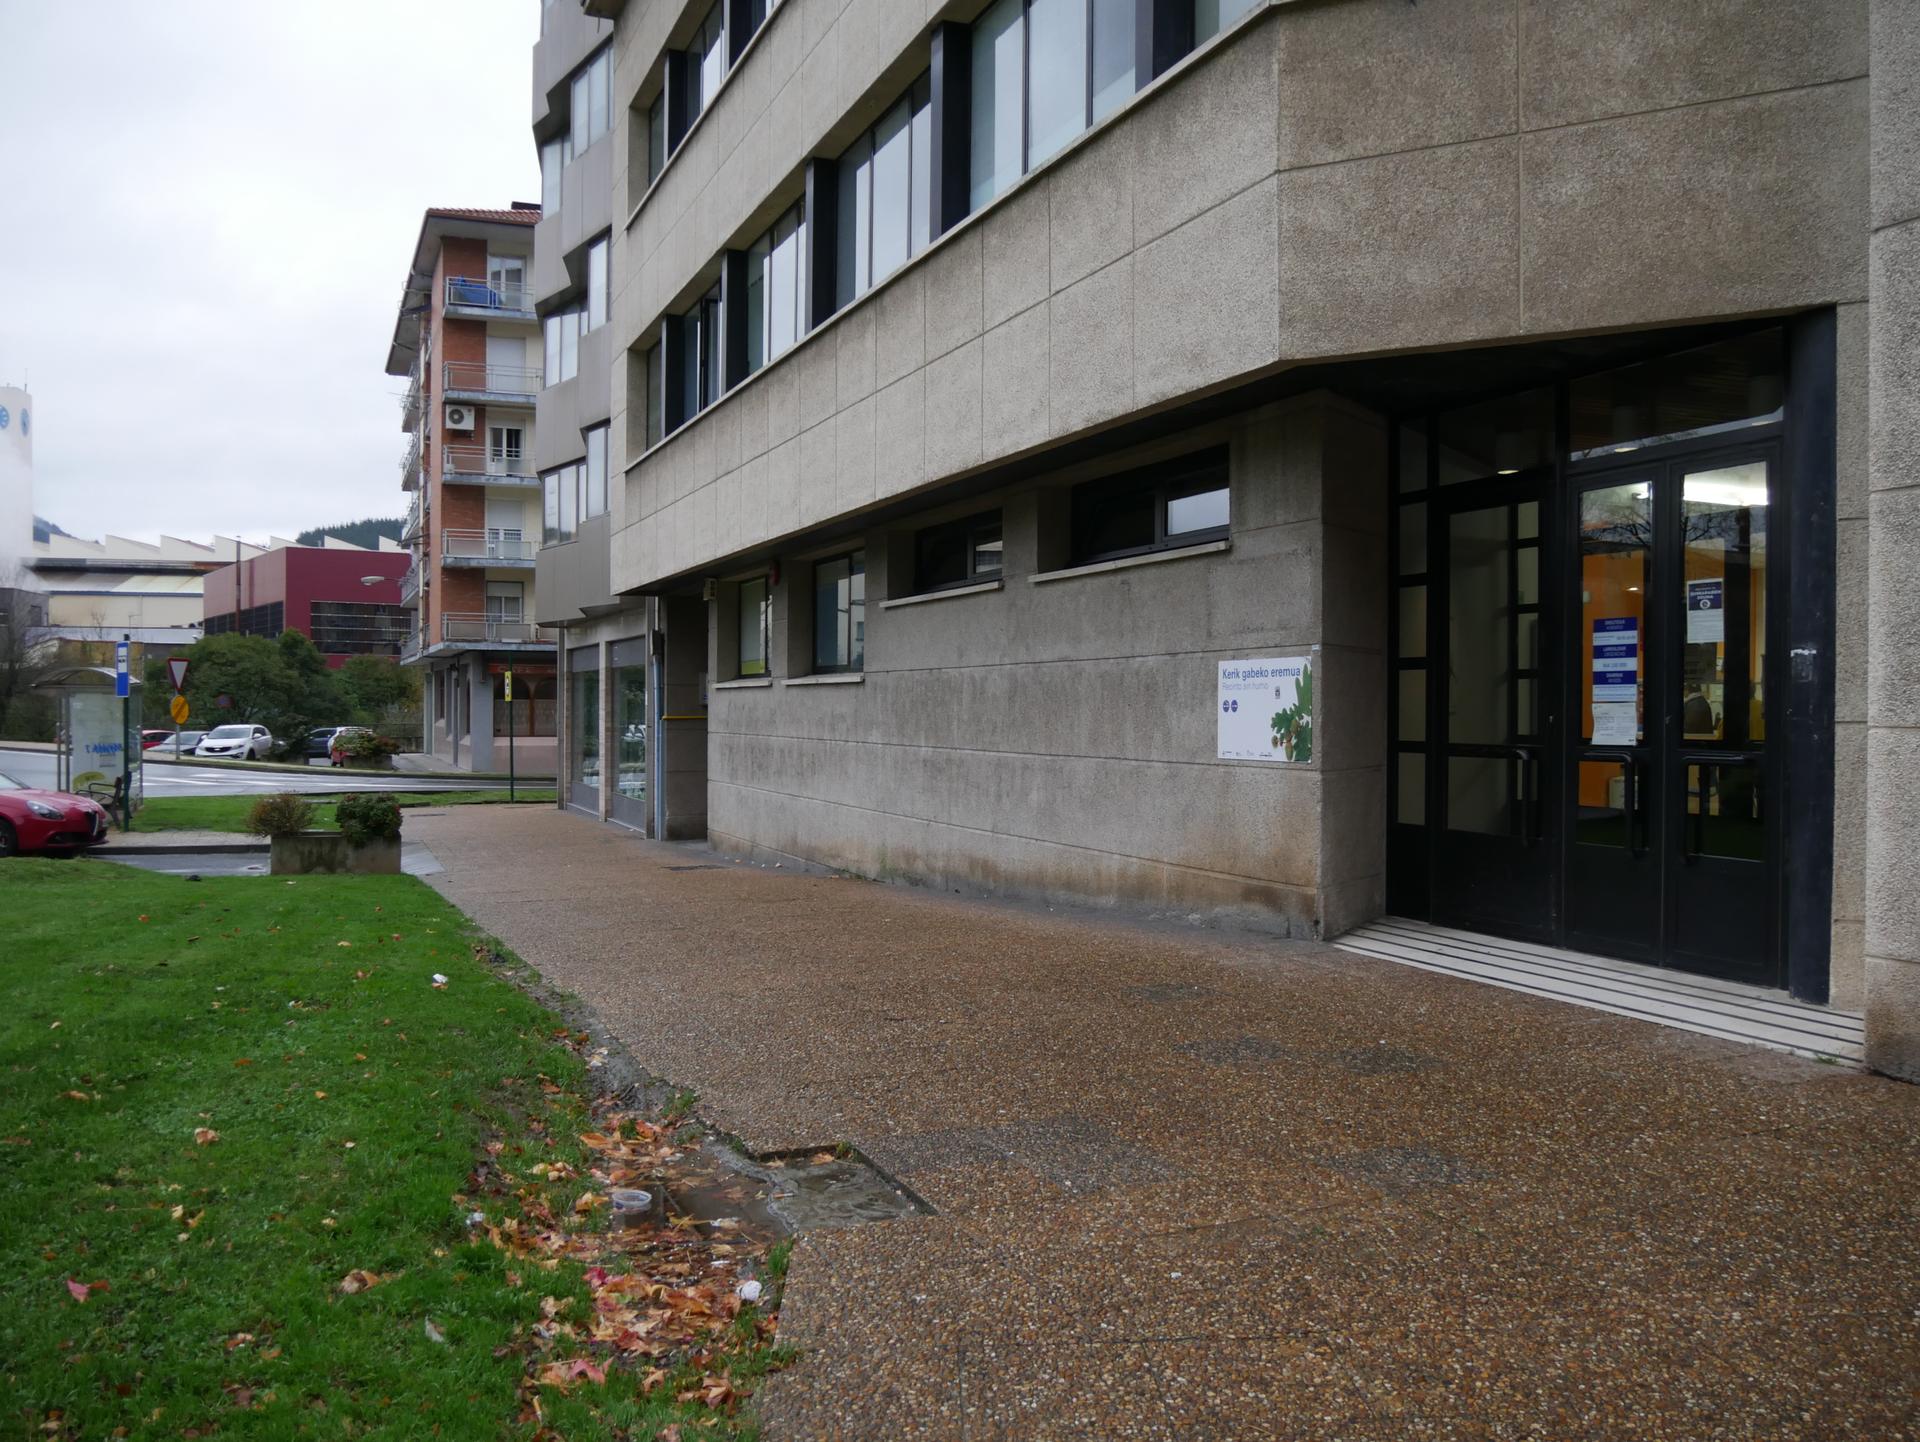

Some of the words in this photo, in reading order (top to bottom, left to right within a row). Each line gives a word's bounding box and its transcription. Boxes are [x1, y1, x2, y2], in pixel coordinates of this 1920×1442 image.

[1222, 668, 1240, 679] Kerik
[1242, 667, 1268, 681] gabeko
[1271, 668, 1300, 677] eremua
